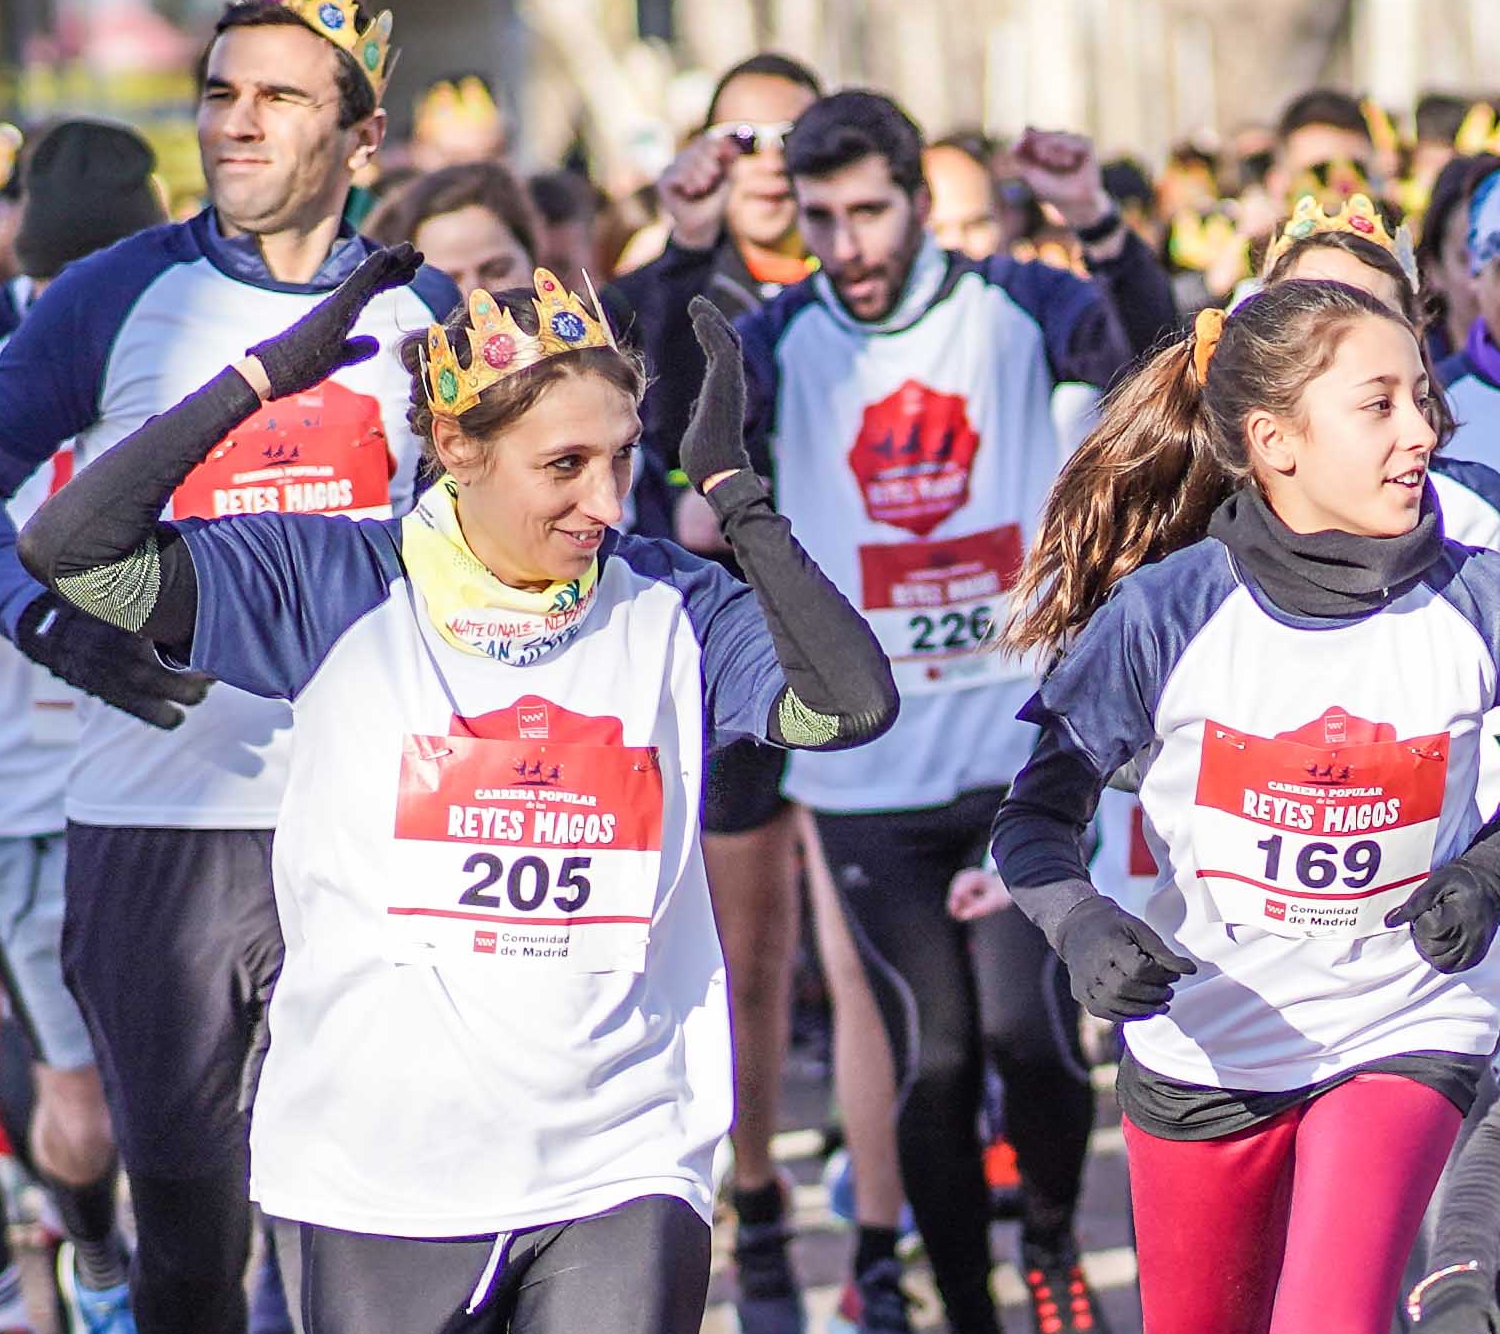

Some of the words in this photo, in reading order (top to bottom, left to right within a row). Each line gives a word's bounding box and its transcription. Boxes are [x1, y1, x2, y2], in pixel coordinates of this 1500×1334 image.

[212, 486, 279, 517] REYES
[284, 478, 353, 513] MAGOS
[908, 605, 996, 653] 226
[474, 788, 536, 802] CARRERA
[537, 789, 597, 807] POPULAR
[1267, 780, 1325, 798] CARRERA
[1328, 786, 1384, 799] POPULAR
[447, 804, 525, 843] REYES
[532, 810, 617, 845] MAGOS
[1241, 788, 1315, 831] REYES
[1323, 798, 1401, 834] MAGOS
[1257, 834, 1382, 889] 169
[458, 852, 592, 913] 205
[1288, 917, 1306, 925] de
[1310, 917, 1357, 927] Madrid
[1290, 904, 1359, 916] Comunidad
[500, 946, 517, 958] de
[522, 946, 569, 959] Madrid
[501, 932, 570, 945] Comunidad
